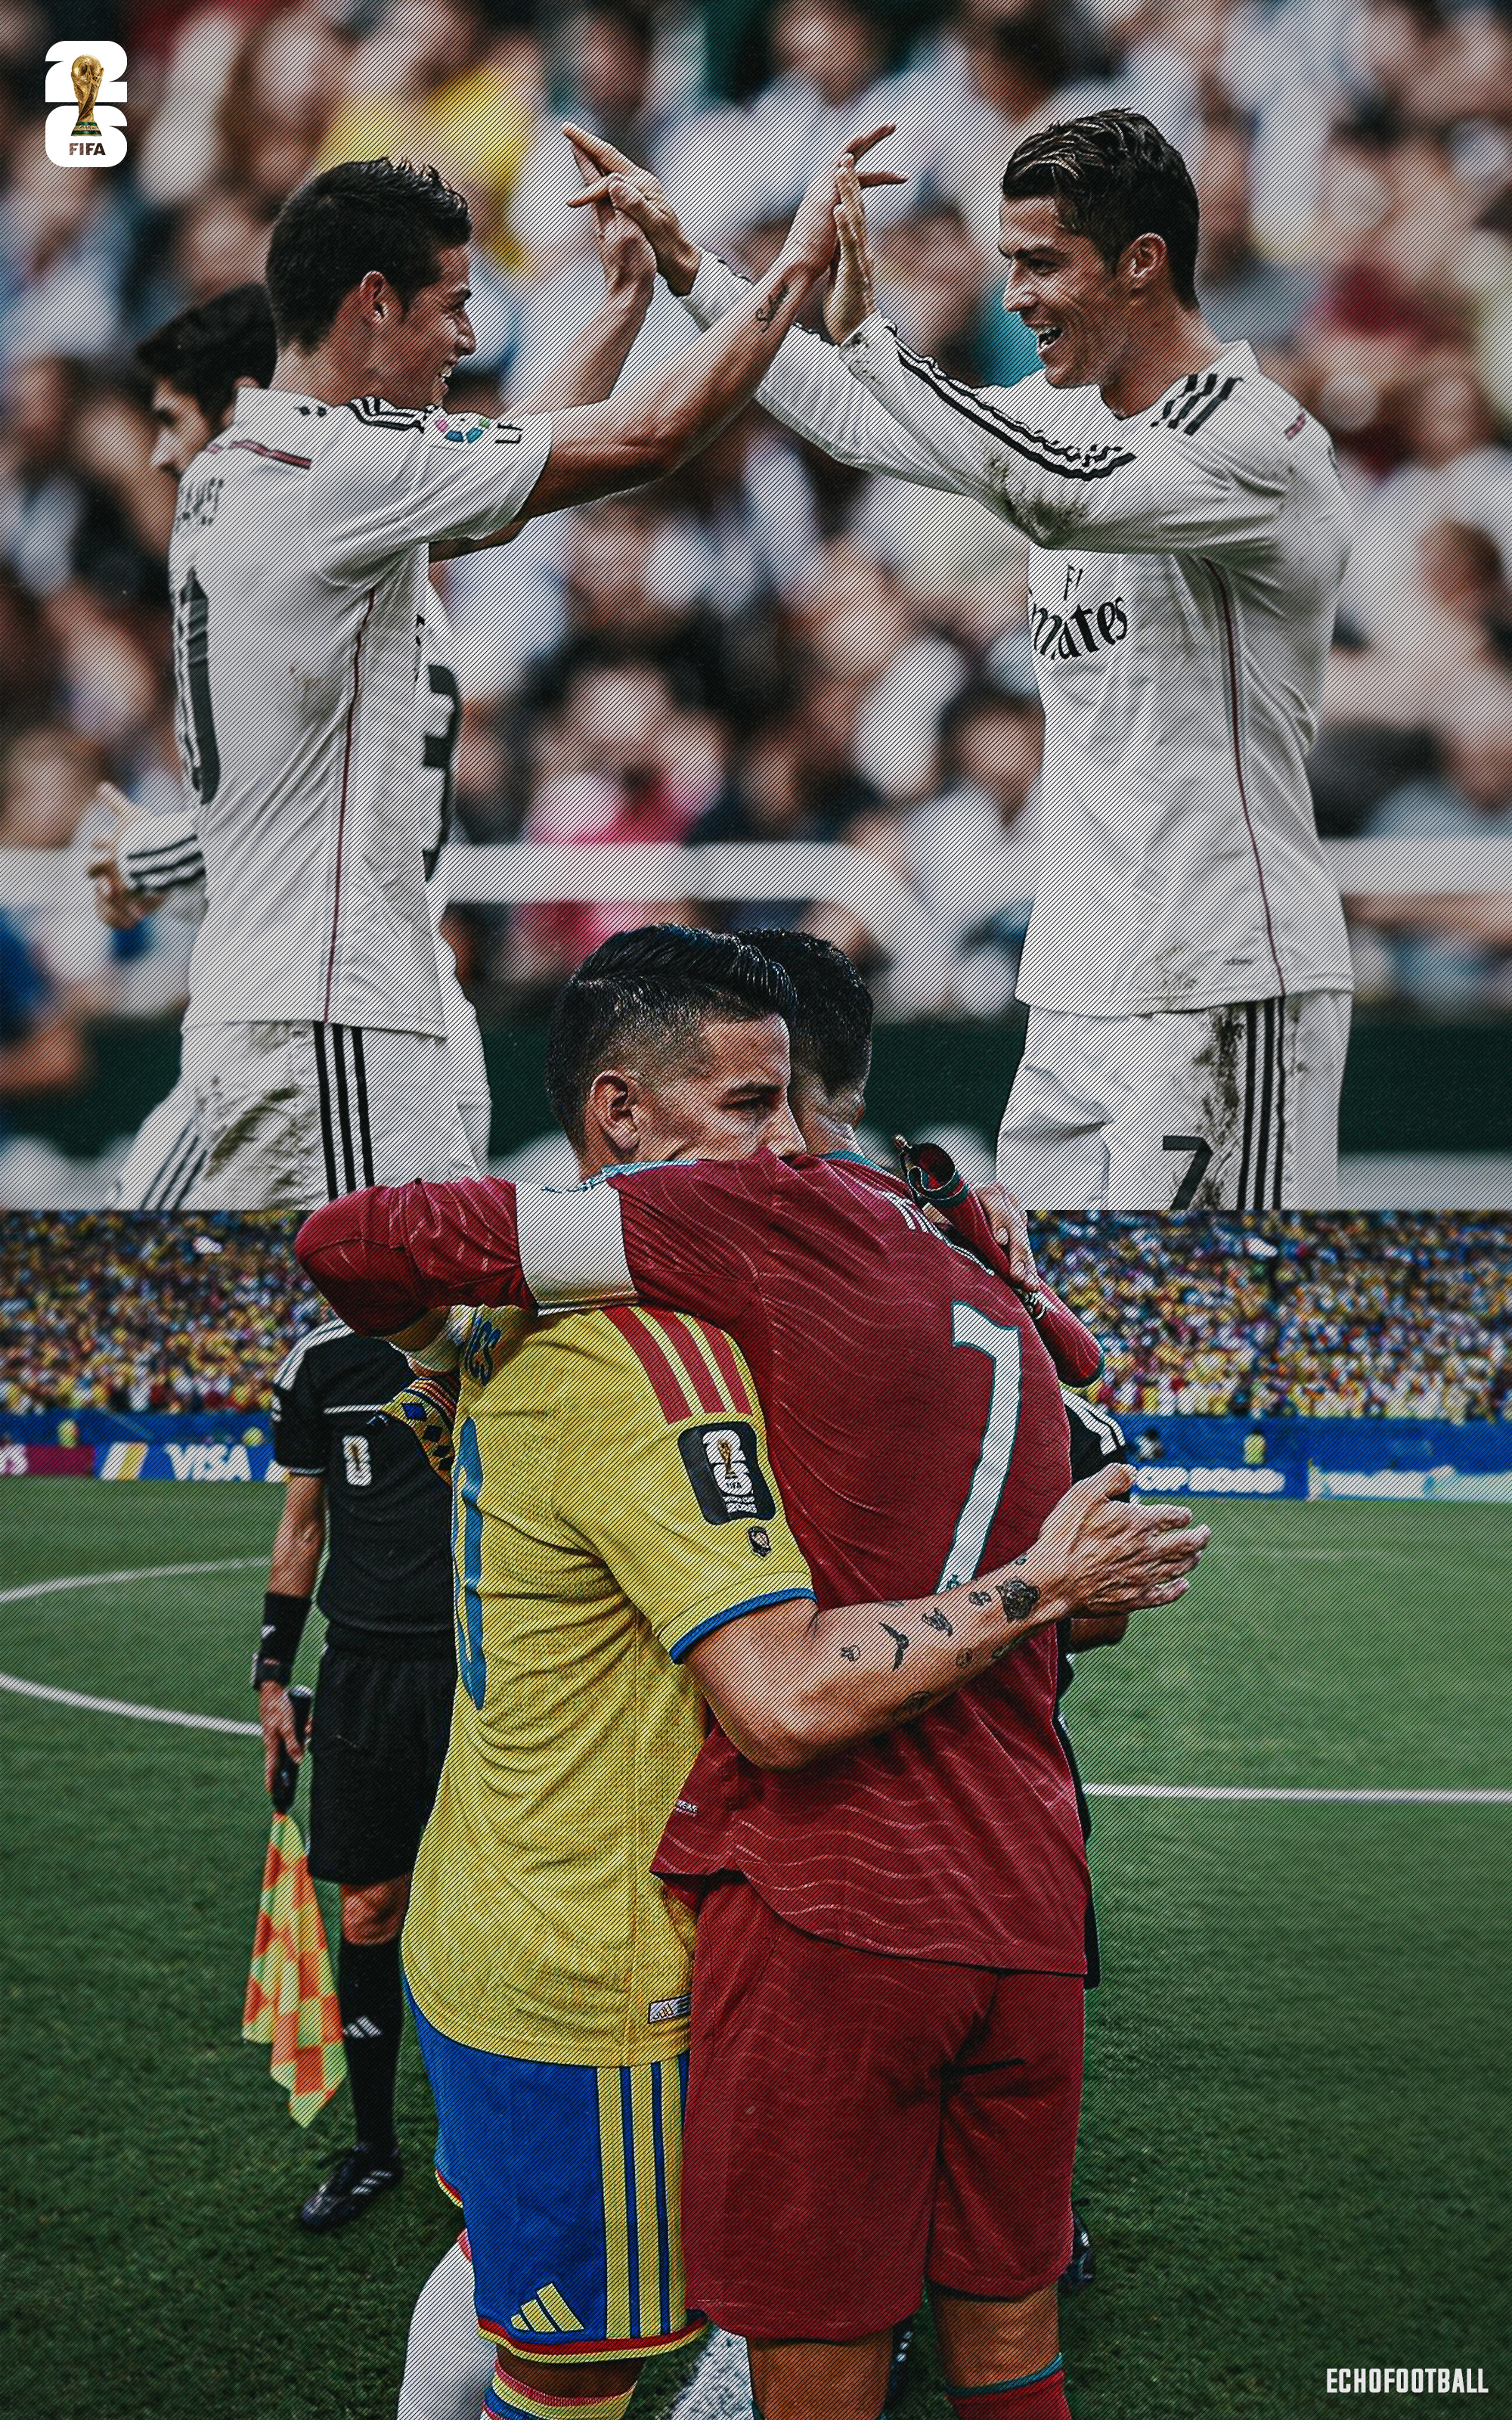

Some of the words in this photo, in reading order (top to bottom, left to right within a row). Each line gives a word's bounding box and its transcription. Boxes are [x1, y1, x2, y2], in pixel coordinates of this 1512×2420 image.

[1162, 1135, 1214, 1210] 7
[164, 1443, 252, 1481] VISA
[936, 1299, 1023, 1595] 7
